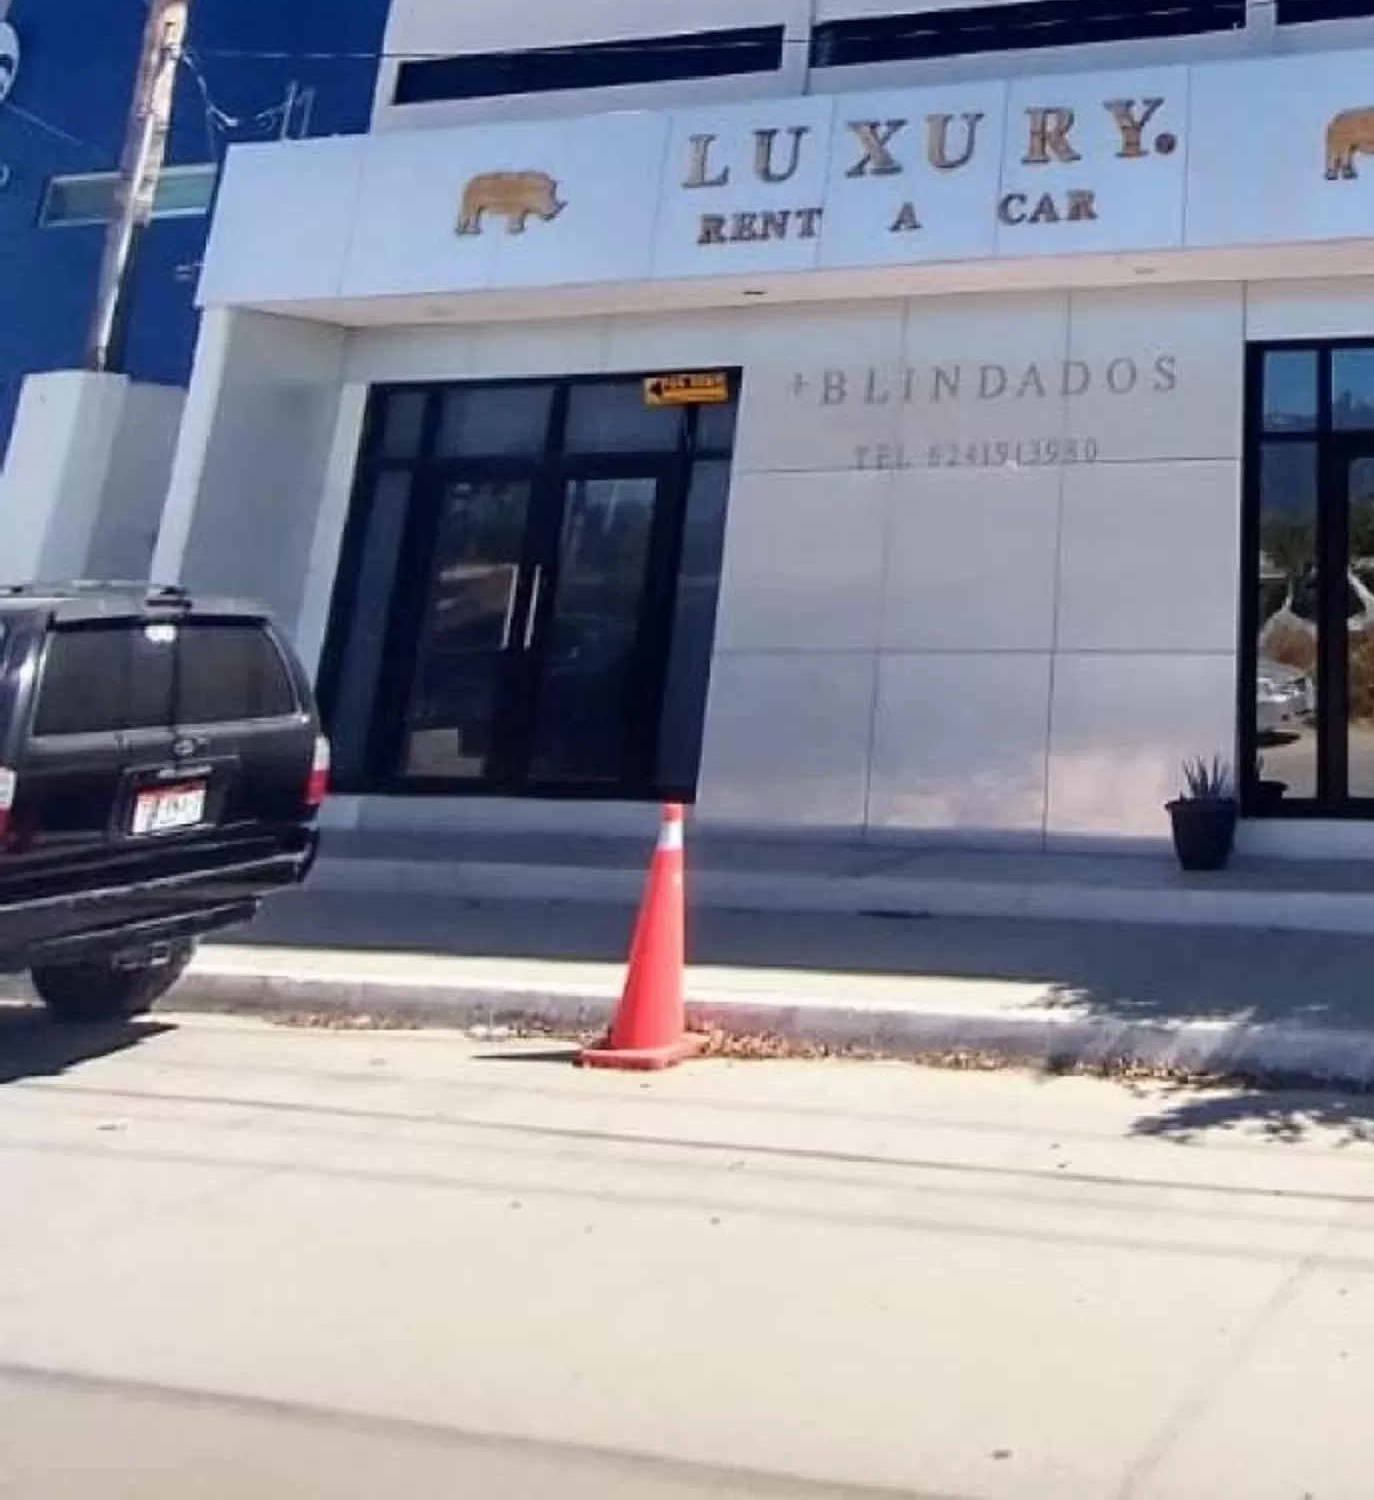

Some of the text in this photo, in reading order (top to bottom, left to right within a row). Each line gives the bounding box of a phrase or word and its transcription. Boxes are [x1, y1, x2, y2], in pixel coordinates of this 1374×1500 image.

[697, 189, 1098, 245] RENT A CAR
[853, 443, 912, 471] TEL
